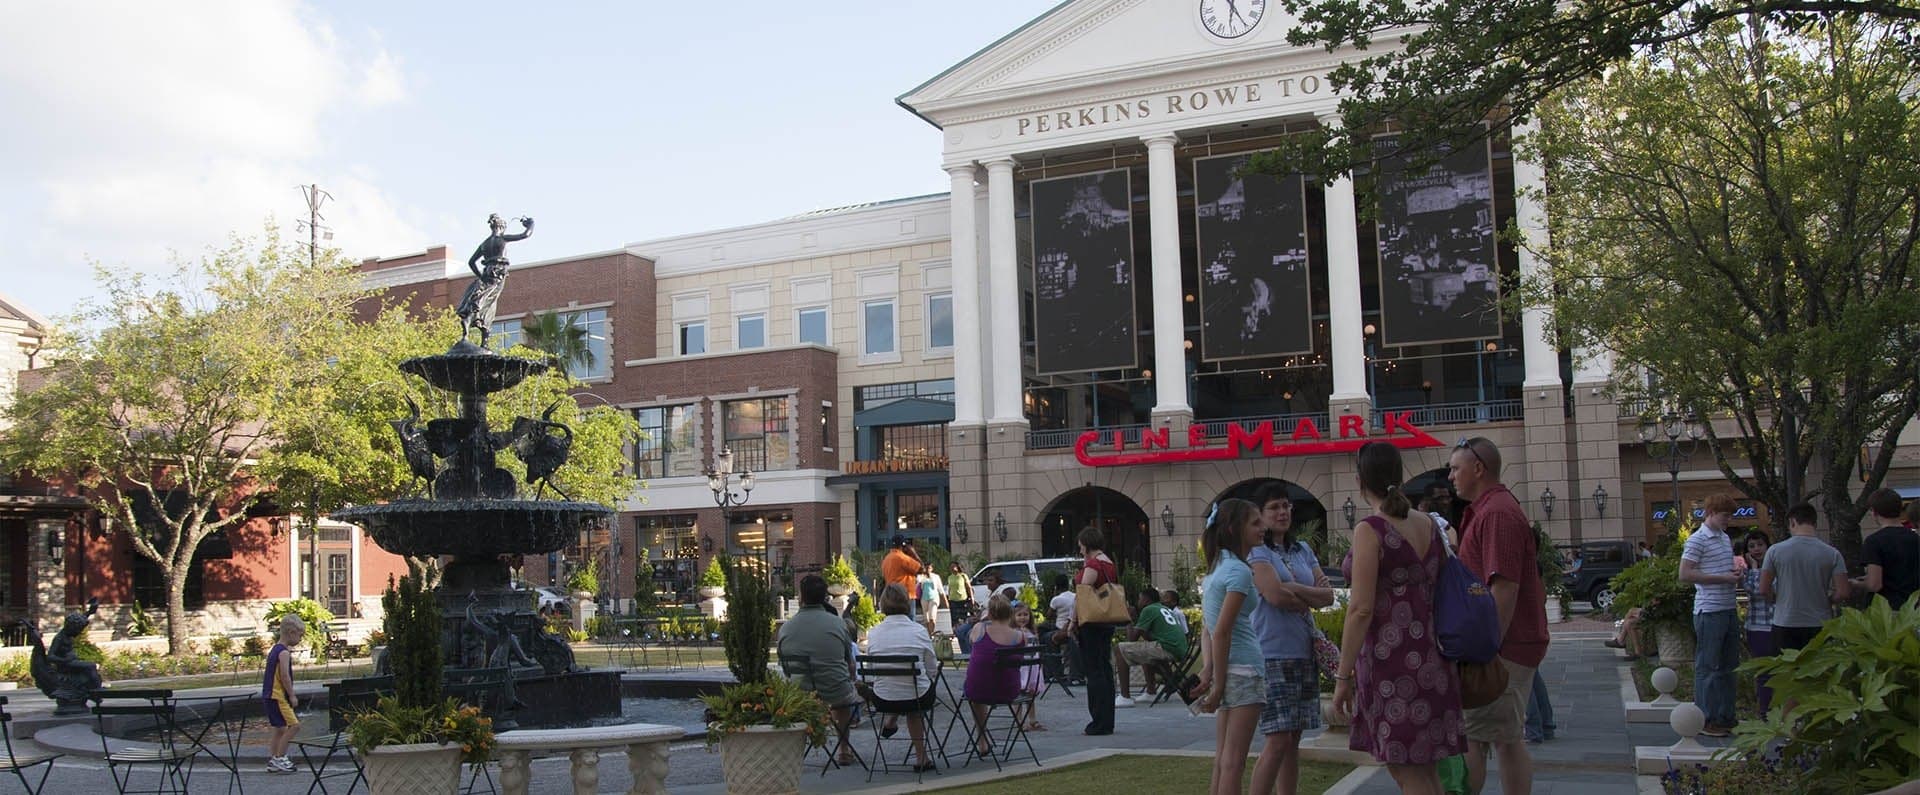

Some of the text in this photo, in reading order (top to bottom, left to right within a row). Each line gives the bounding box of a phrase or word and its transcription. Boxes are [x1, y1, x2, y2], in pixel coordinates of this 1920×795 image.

[1018, 75, 1320, 135] PERKINS ROWE TO
[1074, 411, 1446, 466] CINEMARK
[845, 461, 886, 473] URBAN
